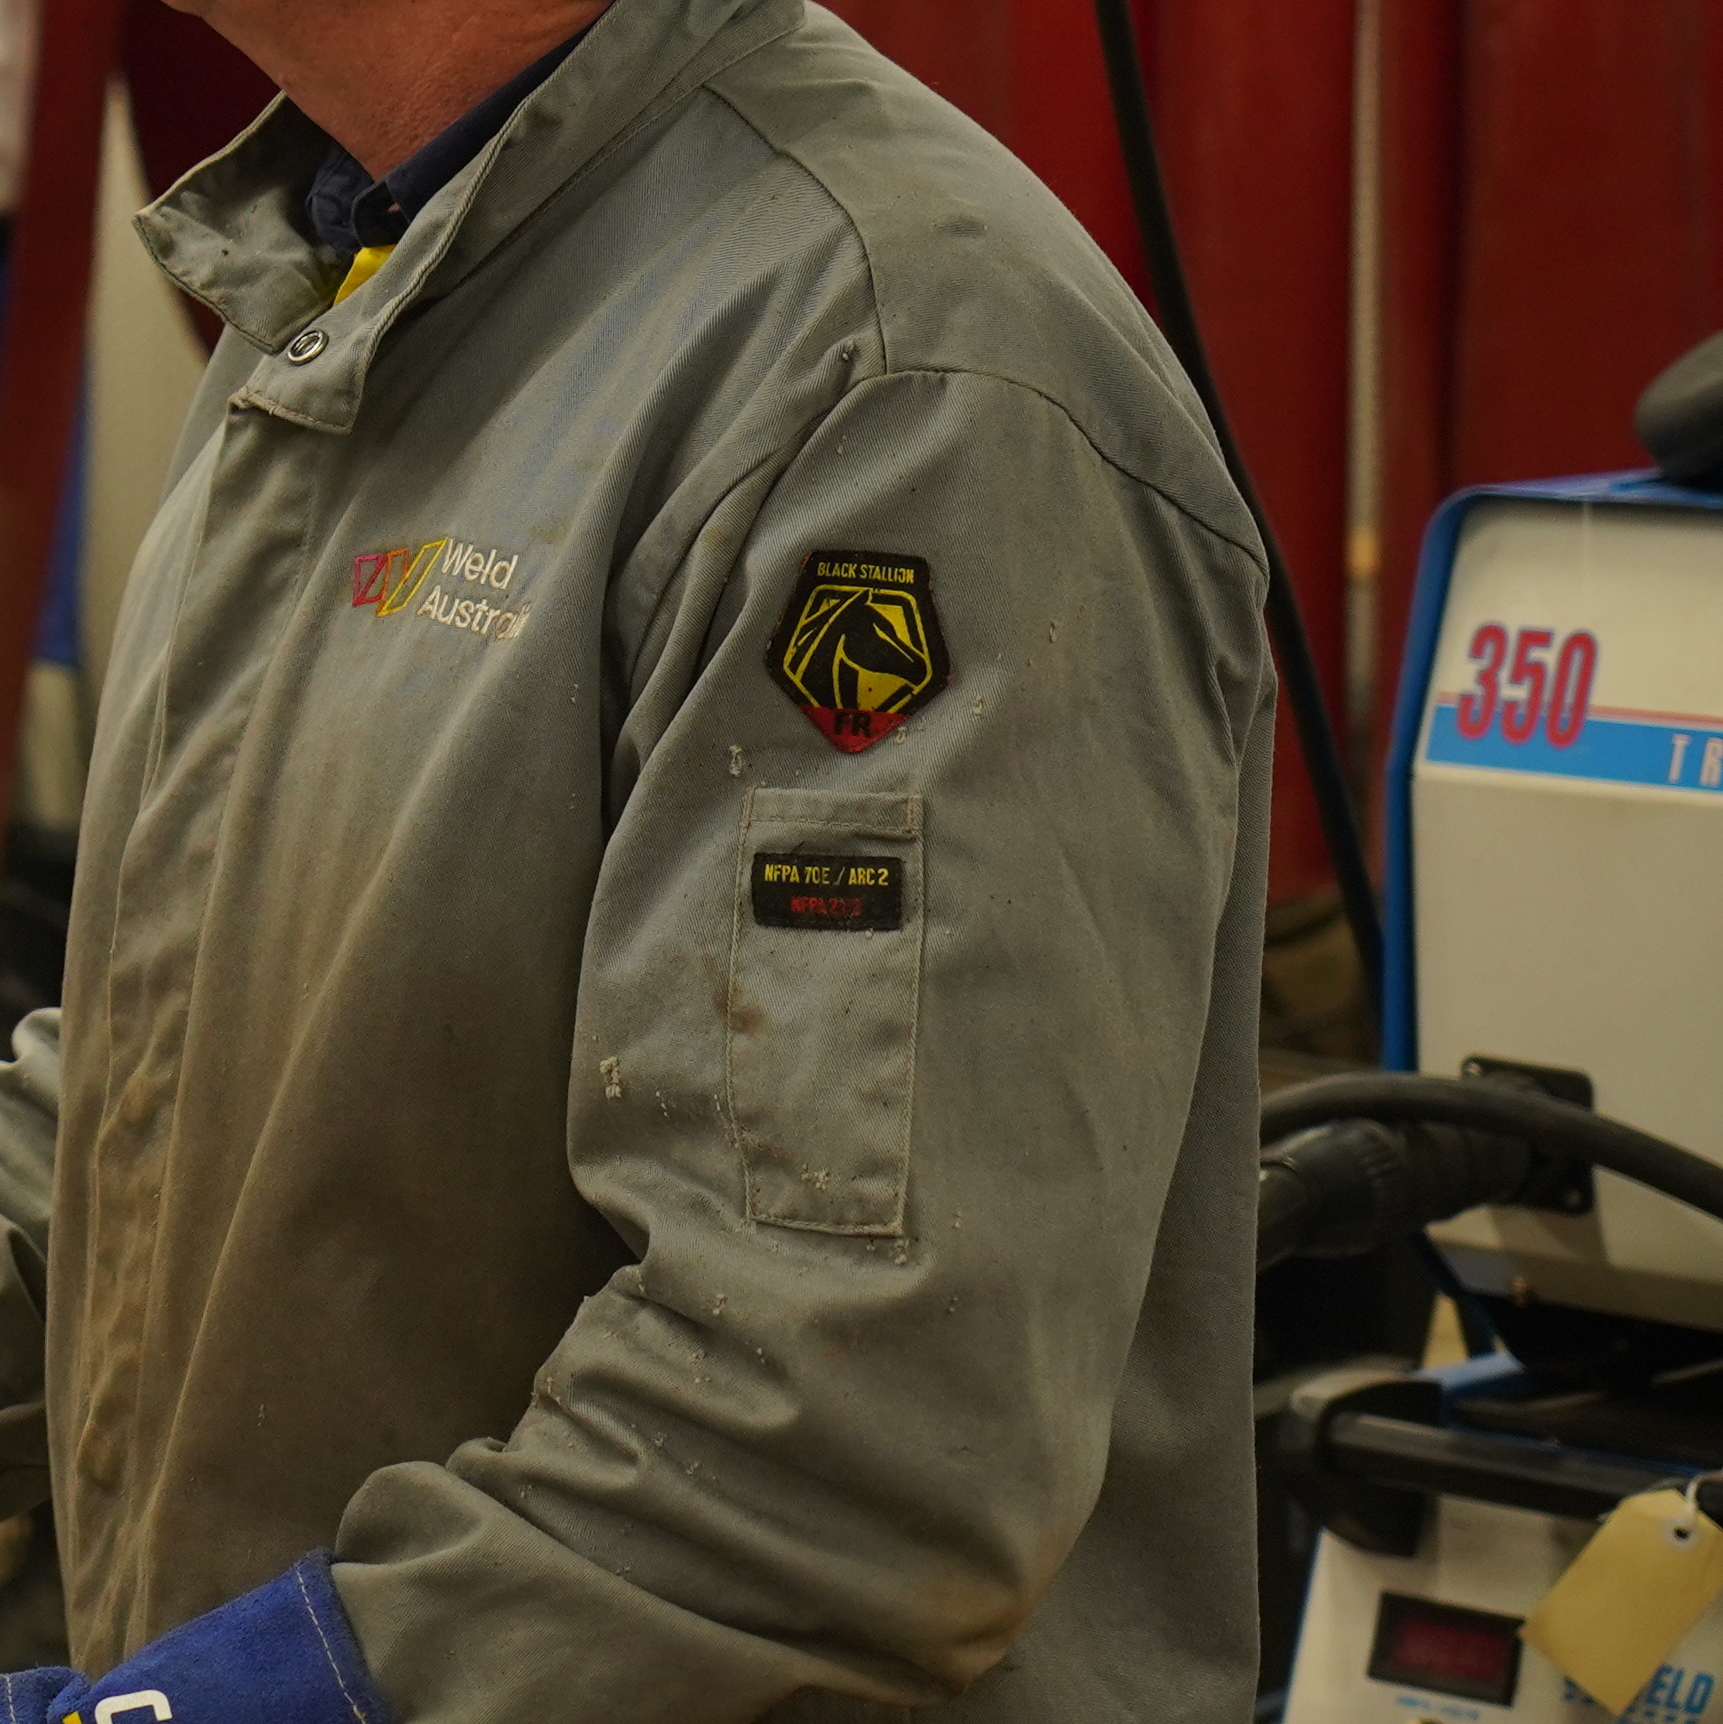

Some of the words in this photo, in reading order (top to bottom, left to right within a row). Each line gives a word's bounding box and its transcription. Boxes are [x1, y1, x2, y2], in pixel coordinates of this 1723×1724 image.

[441, 538, 519, 589] Weld
[817, 561, 857, 580] BLACK
[859, 563, 915, 585] STALLION
[416, 584, 533, 640] Australi
[1457, 624, 1599, 750] 350
[833, 711, 873, 739] FR
[764, 863, 801, 883] NFPA
[804, 866, 830, 885] 70E
[848, 867, 876, 886] ARC
[878, 868, 889, 887] 2
[1646, 1662, 1715, 1716] ELD
